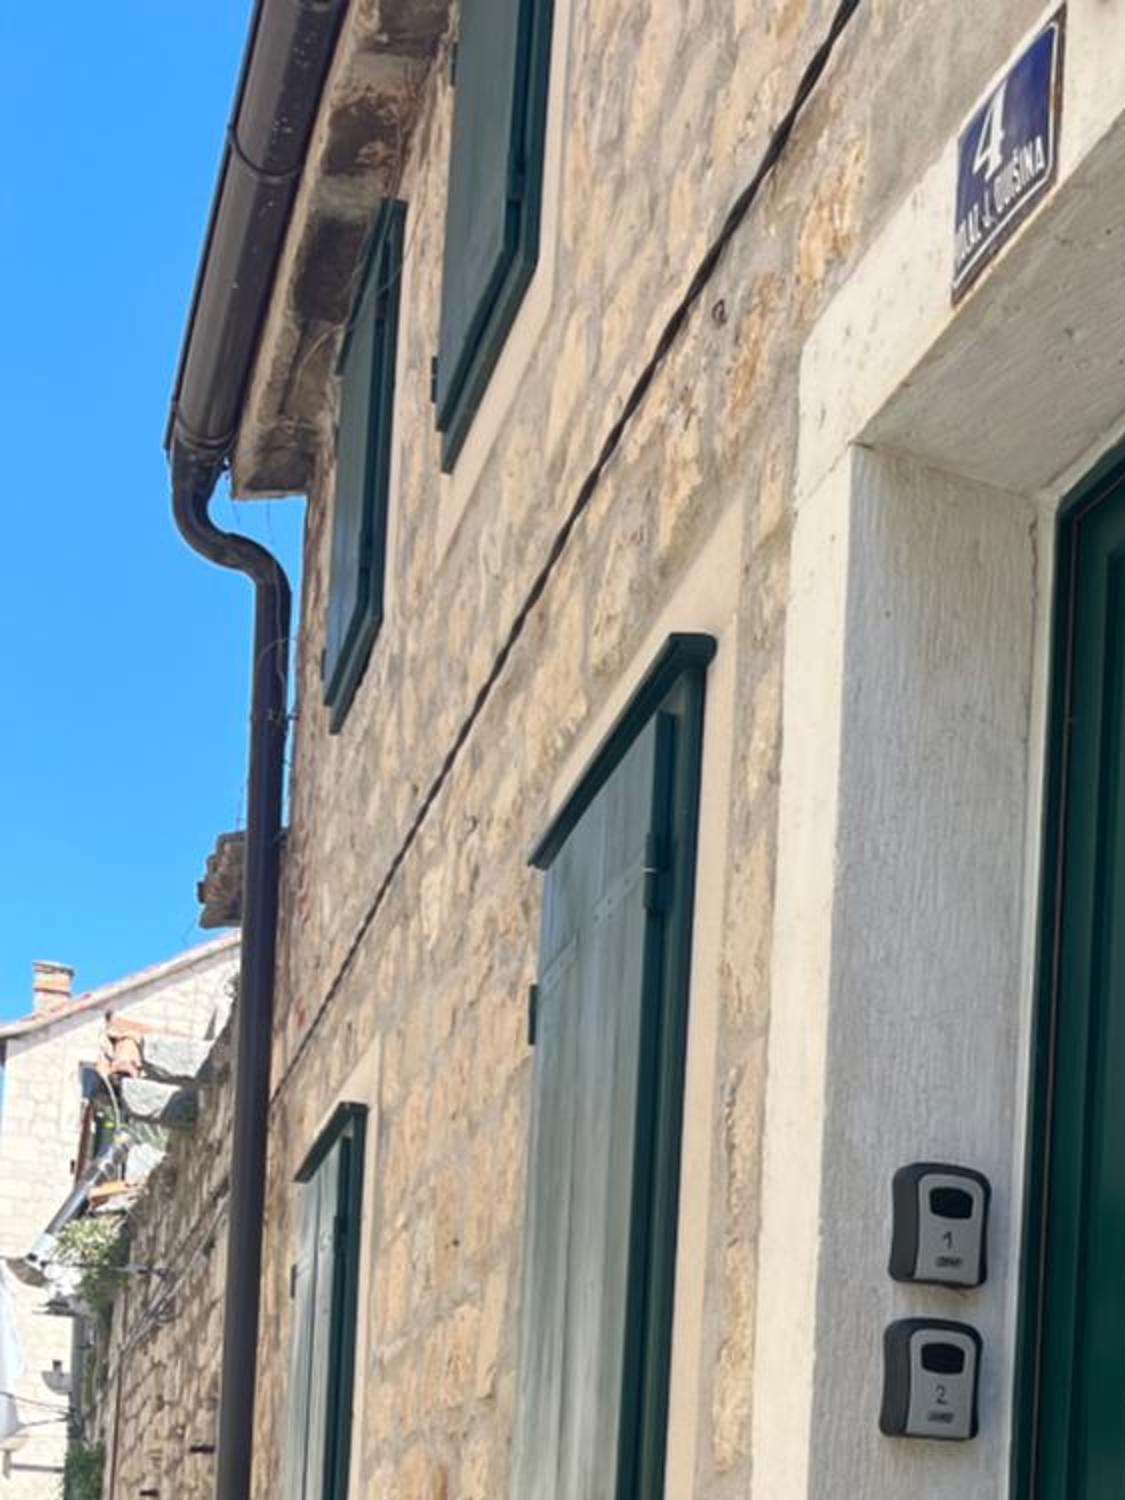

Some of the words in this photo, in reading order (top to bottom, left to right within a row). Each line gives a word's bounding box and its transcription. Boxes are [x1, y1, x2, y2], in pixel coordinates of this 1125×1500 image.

[972, 79, 1008, 181] 4
[943, 1231, 953, 1248] 1
[935, 1384, 948, 1405] 2
